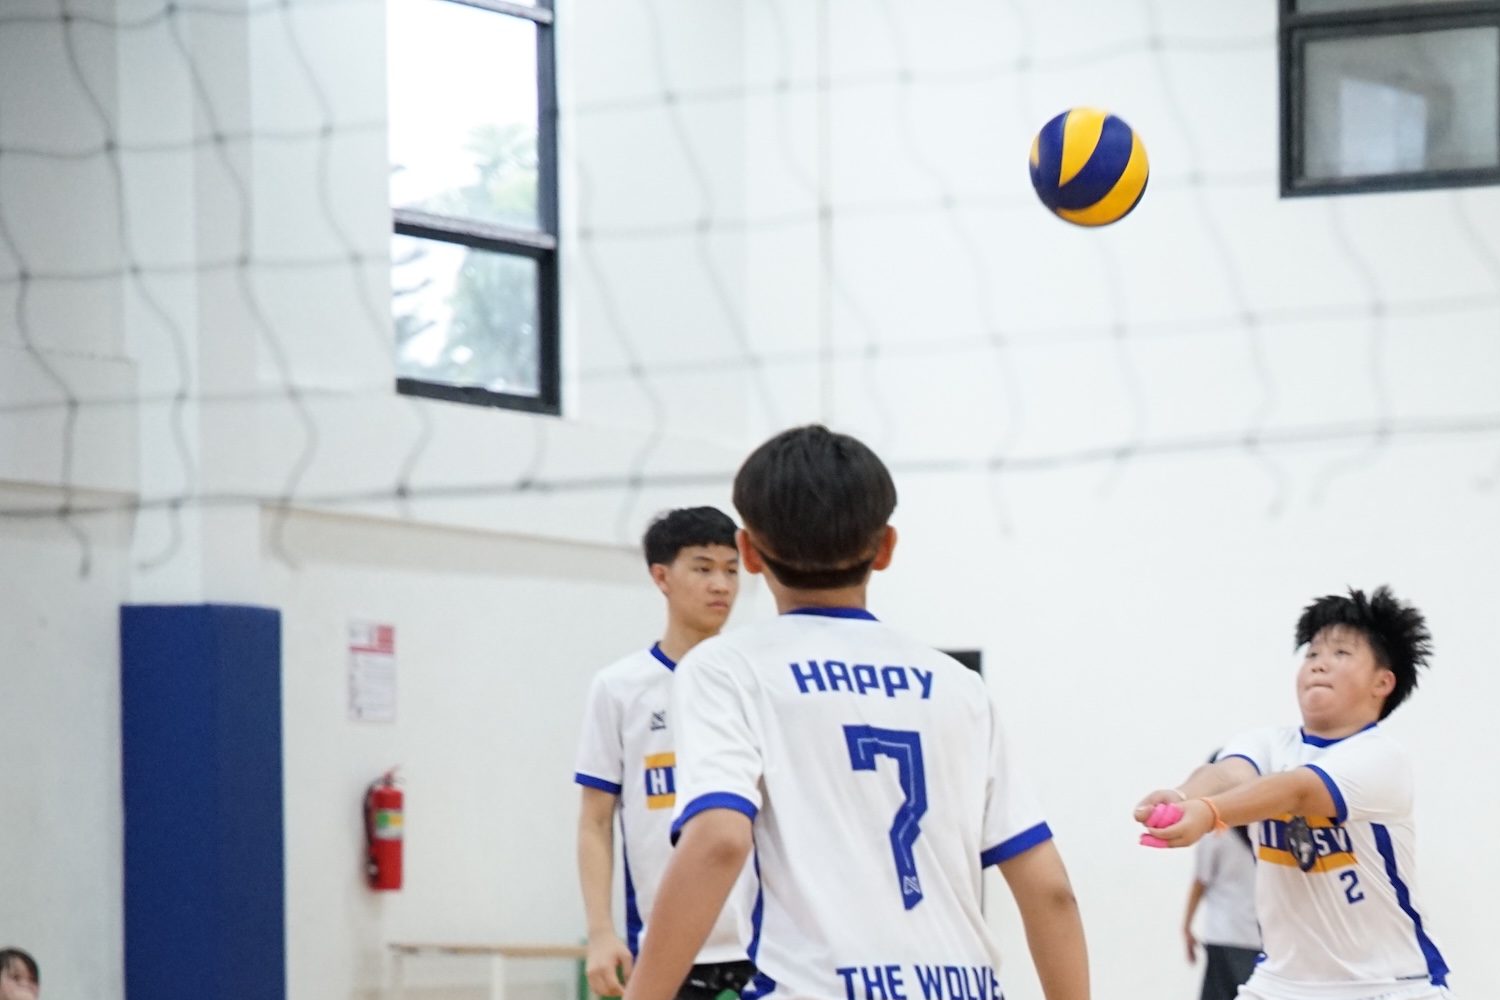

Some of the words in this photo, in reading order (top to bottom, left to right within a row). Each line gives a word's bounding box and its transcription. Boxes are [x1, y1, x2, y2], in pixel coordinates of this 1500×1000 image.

[789, 660, 934, 700] HAPPY
[842, 724, 928, 911] 7
[1339, 869, 1365, 905] 2
